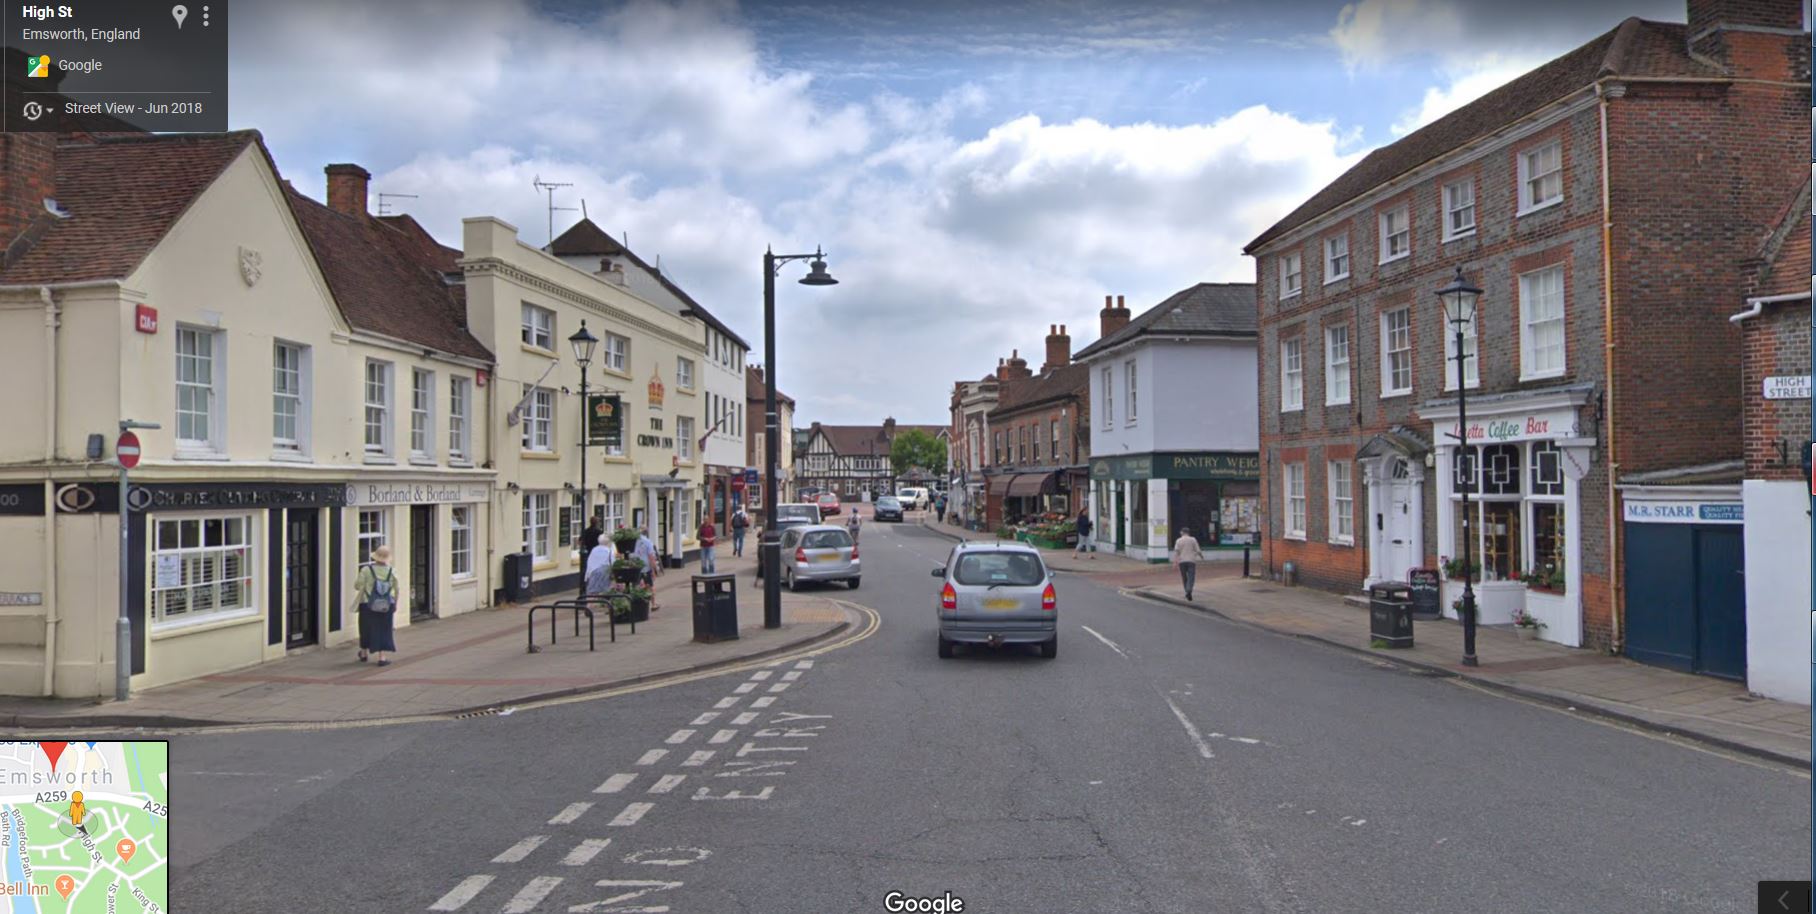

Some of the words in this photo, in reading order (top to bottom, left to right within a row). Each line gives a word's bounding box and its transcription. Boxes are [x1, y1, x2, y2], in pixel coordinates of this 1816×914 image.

[1775, 377, 1805, 387] HIGH
[650, 417, 663, 430] THE
[1488, 421, 1520, 440] Coffee
[1525, 416, 1549, 434] Bar
[637, 434, 661, 448] CROWN
[661, 437, 673, 449] INN
[1173, 456, 1219, 468] PANTRY
[368, 484, 411, 503] Borland
[414, 485, 424, 502] &
[426, 484, 460, 501] Borland
[1628, 505, 1652, 517] M.R.
[1654, 505, 1694, 518] STARR
[567, 845, 713, 913] NO
[690, 711, 833, 800] ENTRY
